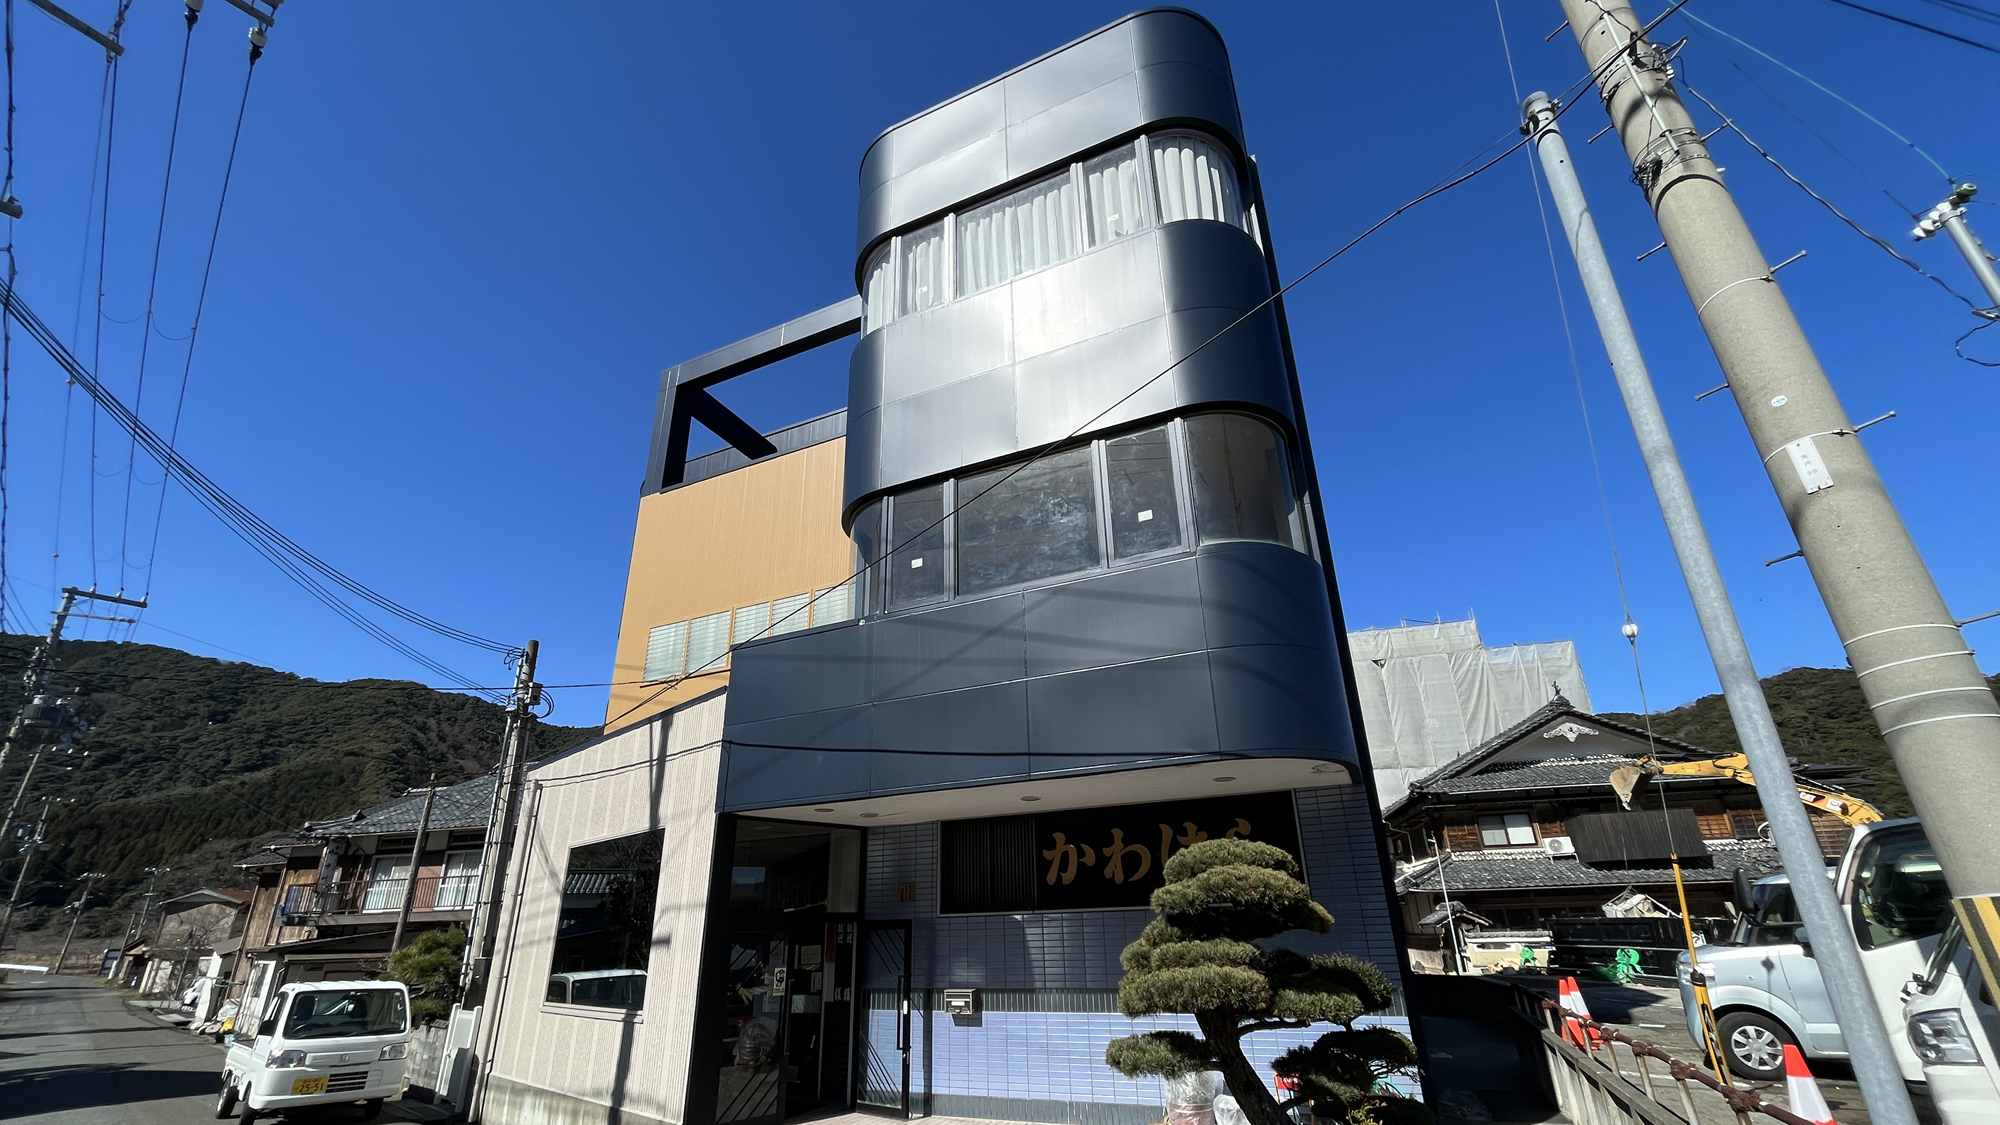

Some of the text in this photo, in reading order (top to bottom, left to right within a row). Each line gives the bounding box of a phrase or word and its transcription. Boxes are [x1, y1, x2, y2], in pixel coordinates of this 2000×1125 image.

[1799, 791, 1816, 803] CAT
[1042, 817, 1252, 886] かわは
[299, 1082, 324, 1093] 25-51
